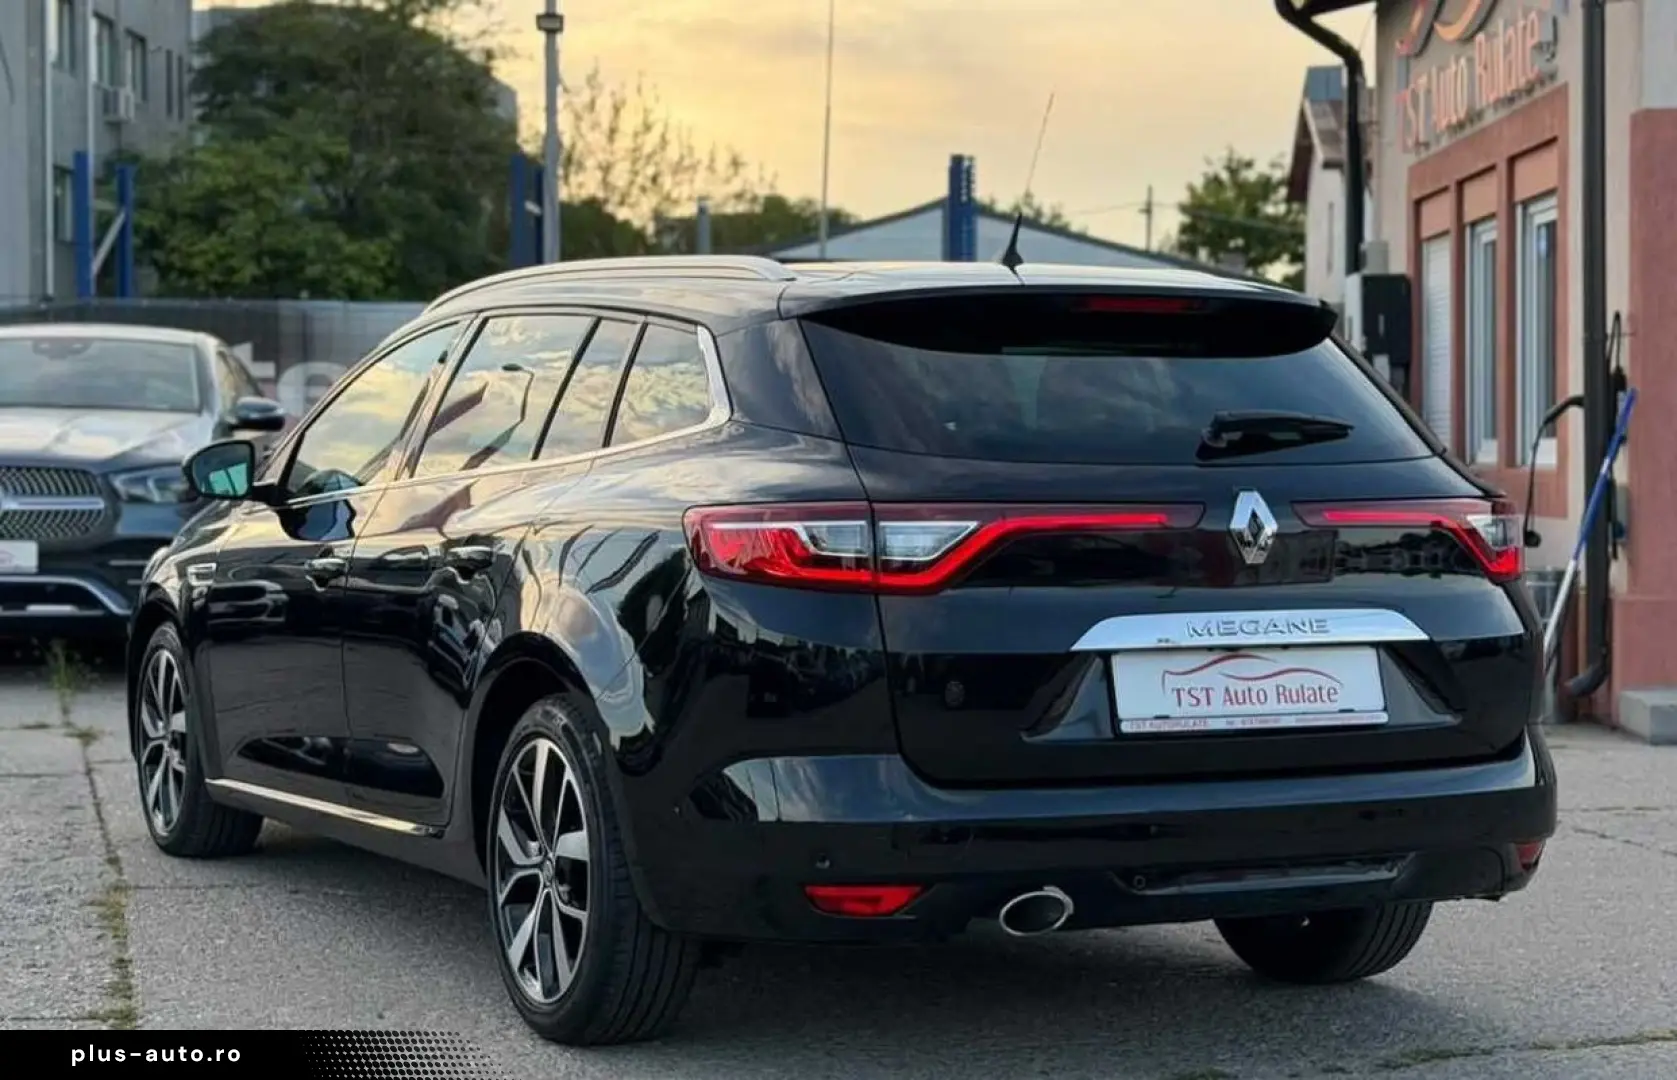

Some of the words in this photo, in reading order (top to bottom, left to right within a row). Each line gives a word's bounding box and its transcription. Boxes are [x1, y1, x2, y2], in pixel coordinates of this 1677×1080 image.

[1395, 75, 1428, 152] TST
[1431, 56, 1468, 133] Auto
[1475, 7, 1541, 110] Rulate
[1186, 618, 1330, 638] MEGANE
[1171, 686, 1214, 708] TST
[1223, 686, 1269, 706] Auto
[1276, 683, 1339, 705] Rulate
